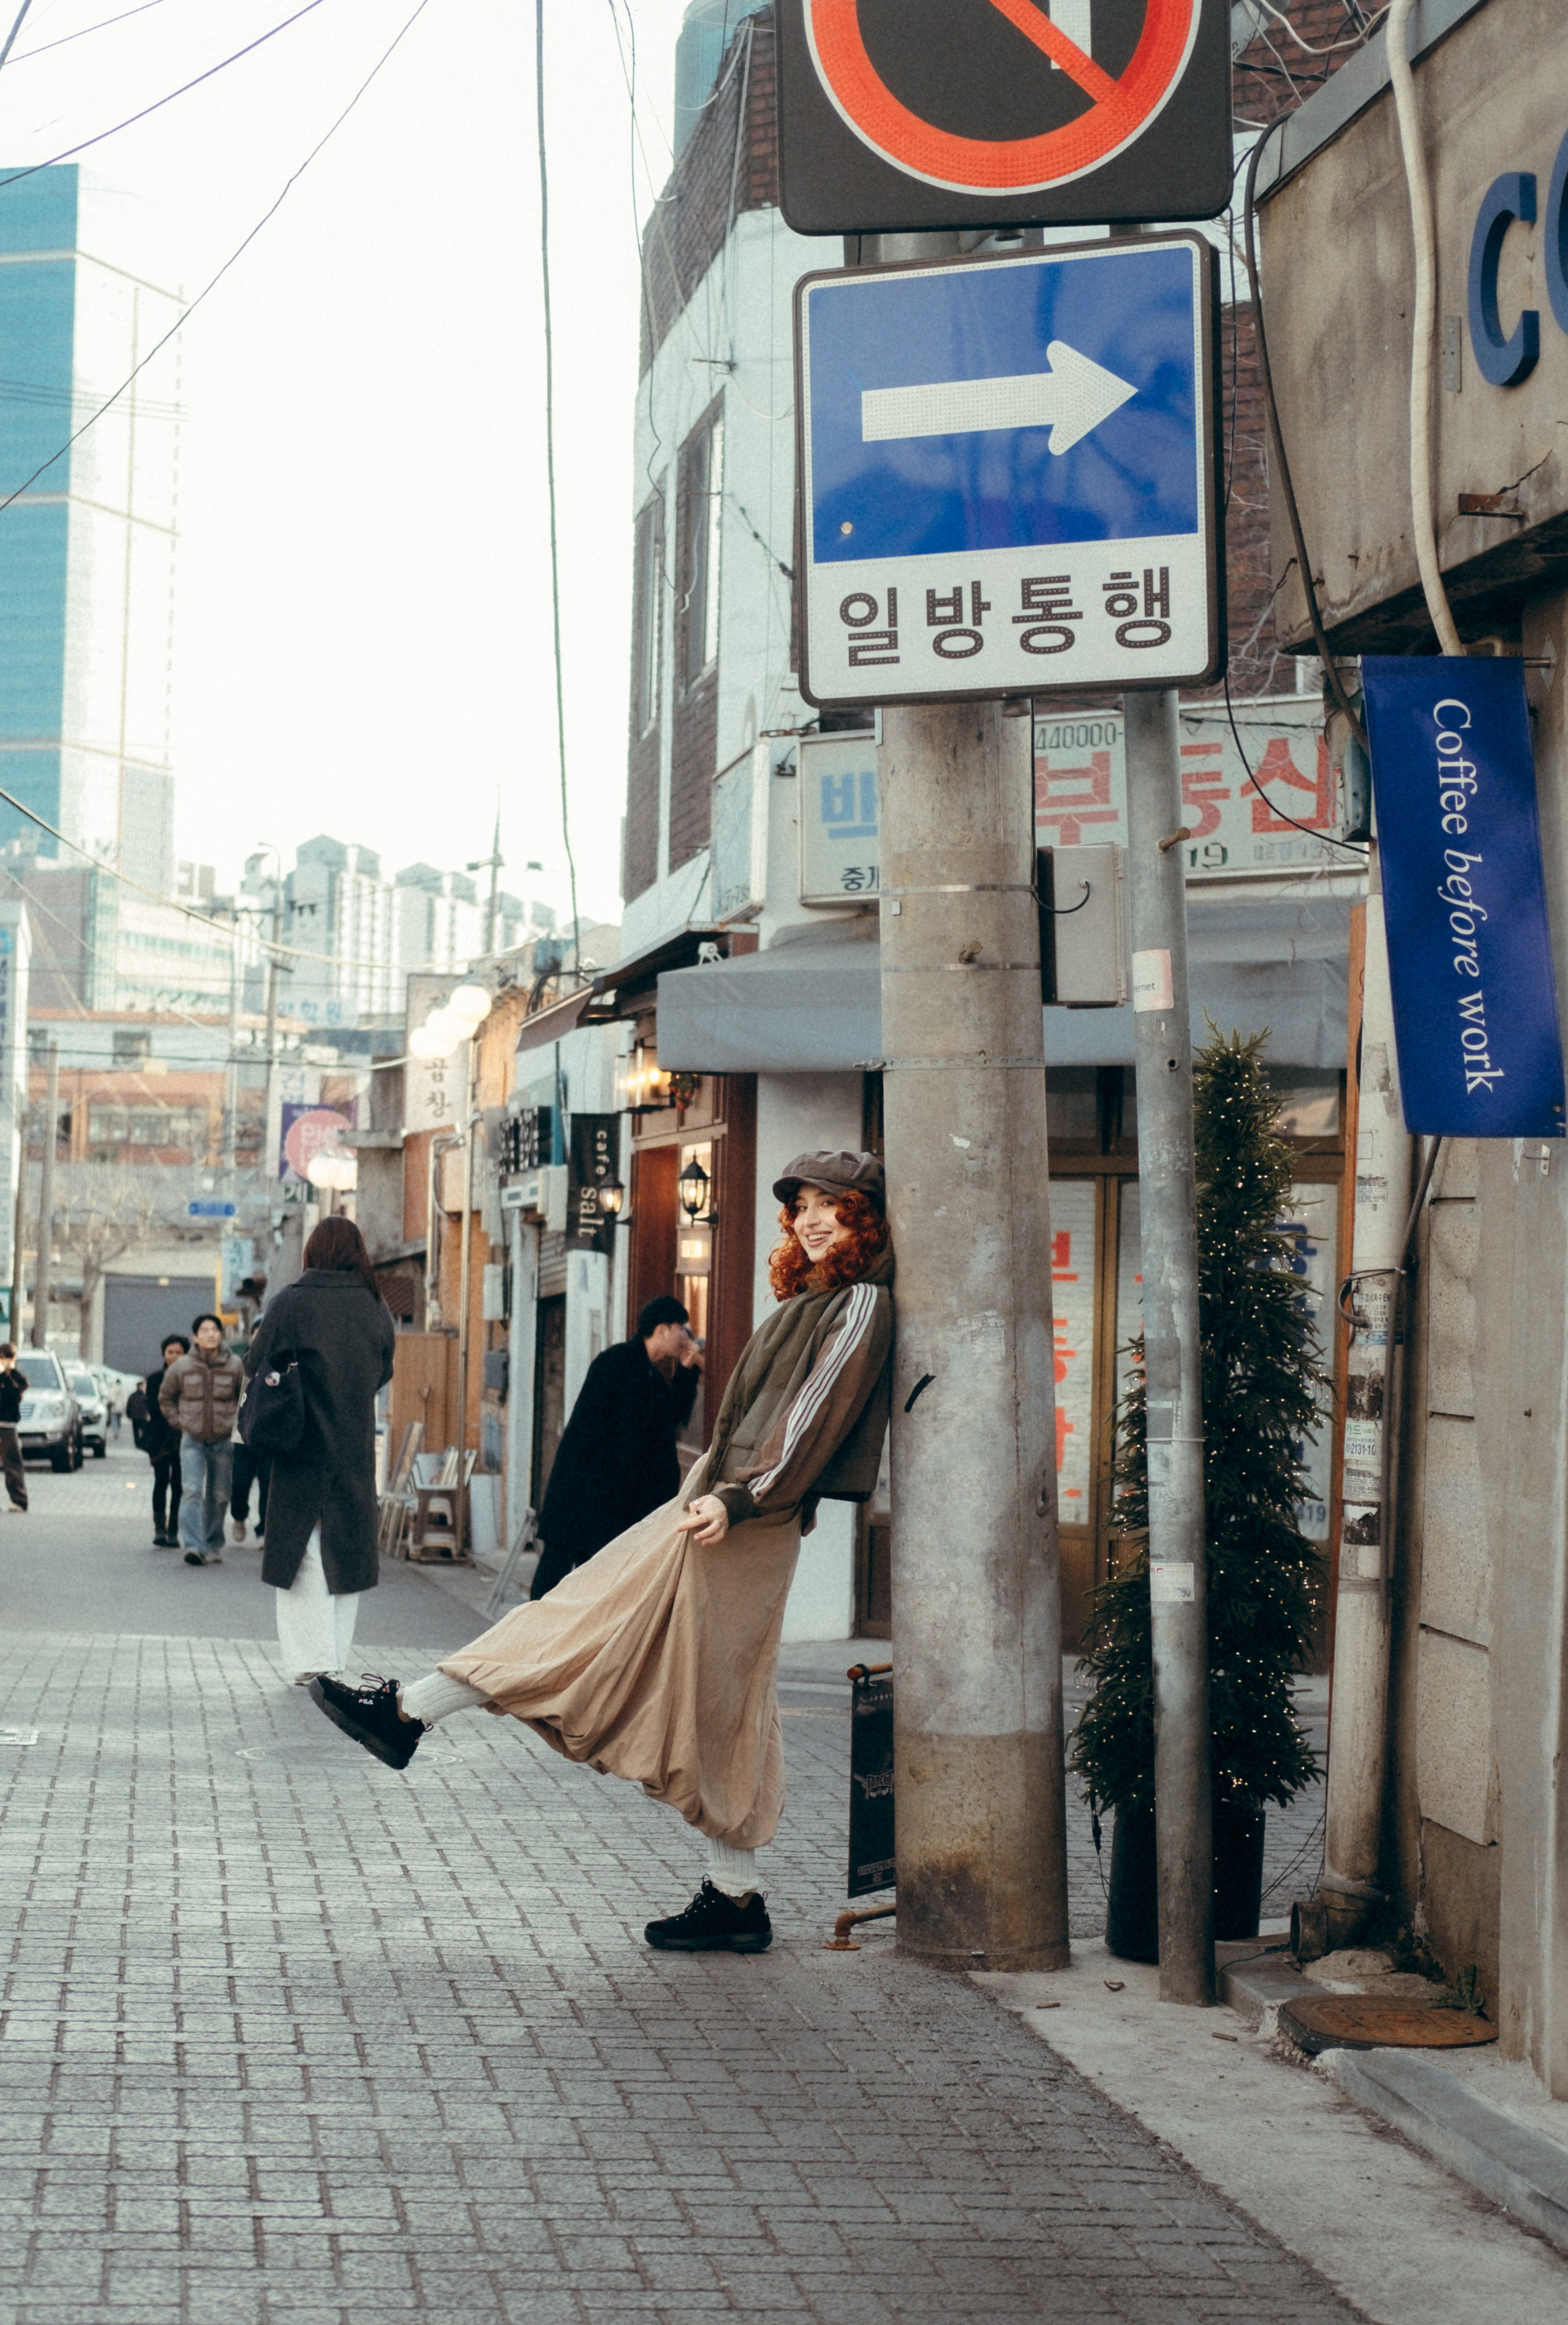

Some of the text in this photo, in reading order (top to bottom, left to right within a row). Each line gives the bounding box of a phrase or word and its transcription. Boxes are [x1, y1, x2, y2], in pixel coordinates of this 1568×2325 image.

[1468, 126, 1568, 387] C
[840, 566, 1172, 667] 일방통행
[1433, 698, 1505, 1095] Coffee before work
[578, 1130, 610, 1238] cafe salt
